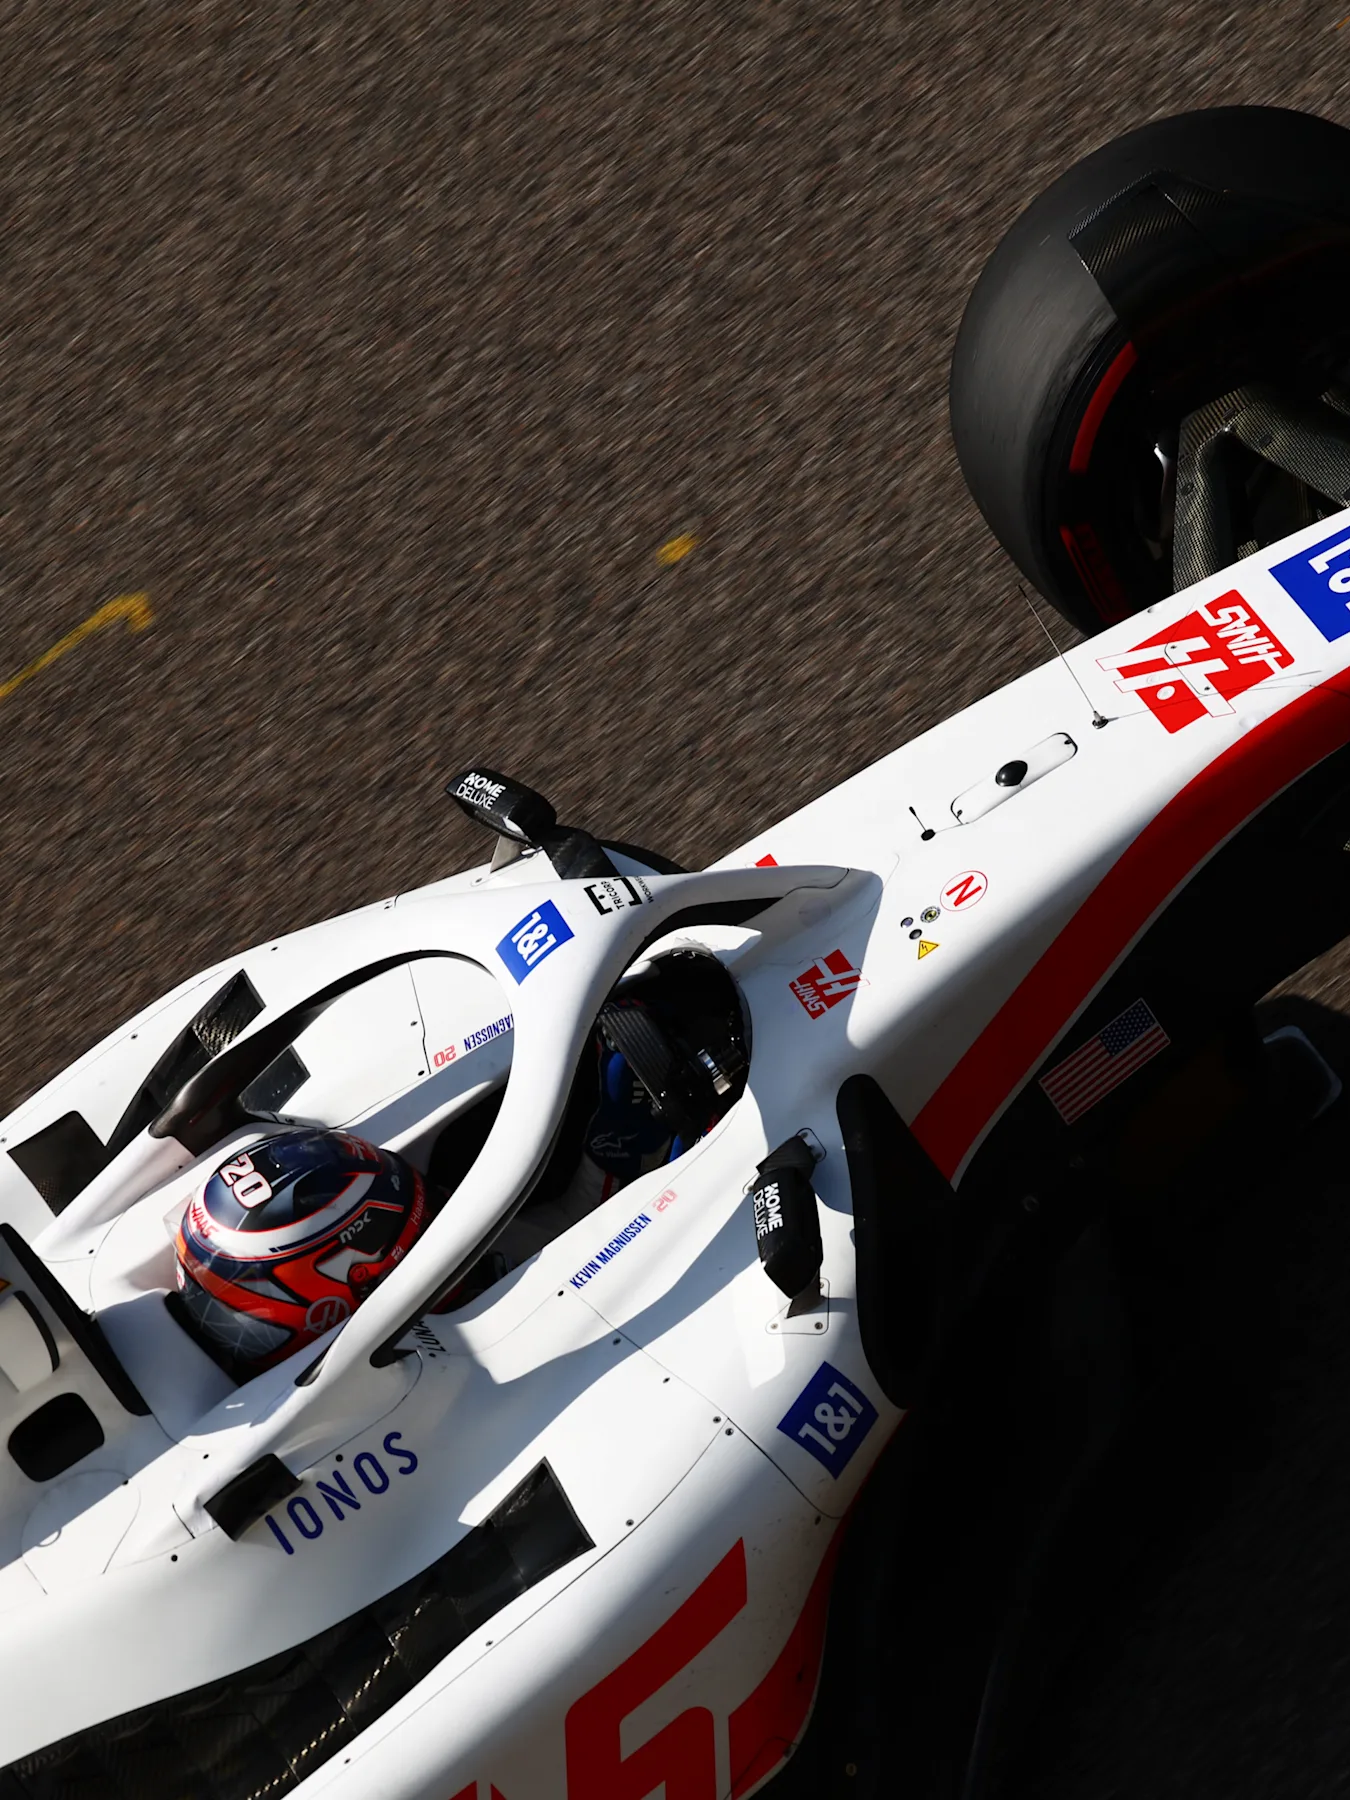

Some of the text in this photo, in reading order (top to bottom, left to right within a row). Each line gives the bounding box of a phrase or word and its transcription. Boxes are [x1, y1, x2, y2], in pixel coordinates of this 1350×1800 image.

[1198, 604, 1284, 674] HAAS
[455, 783, 497, 811] DELUXE
[463, 772, 506, 798] HOME
[600, 880, 625, 911] TRICORP
[636, 876, 654, 904] WORKWE
[511, 911, 557, 967] 1&1
[793, 979, 829, 1012] HAAS
[433, 1013, 514, 1068] AGNUSSEN 20
[219, 1152, 273, 1209] 20
[190, 1201, 220, 1240] HAAS
[753, 1188, 769, 1240] DELUXE
[764, 1182, 784, 1232] HOME
[569, 1189, 678, 1290] KEVIN MAGNUSSEN 20
[797, 1381, 864, 1456] 1&1
[265, 1431, 418, 1555] IONOS
